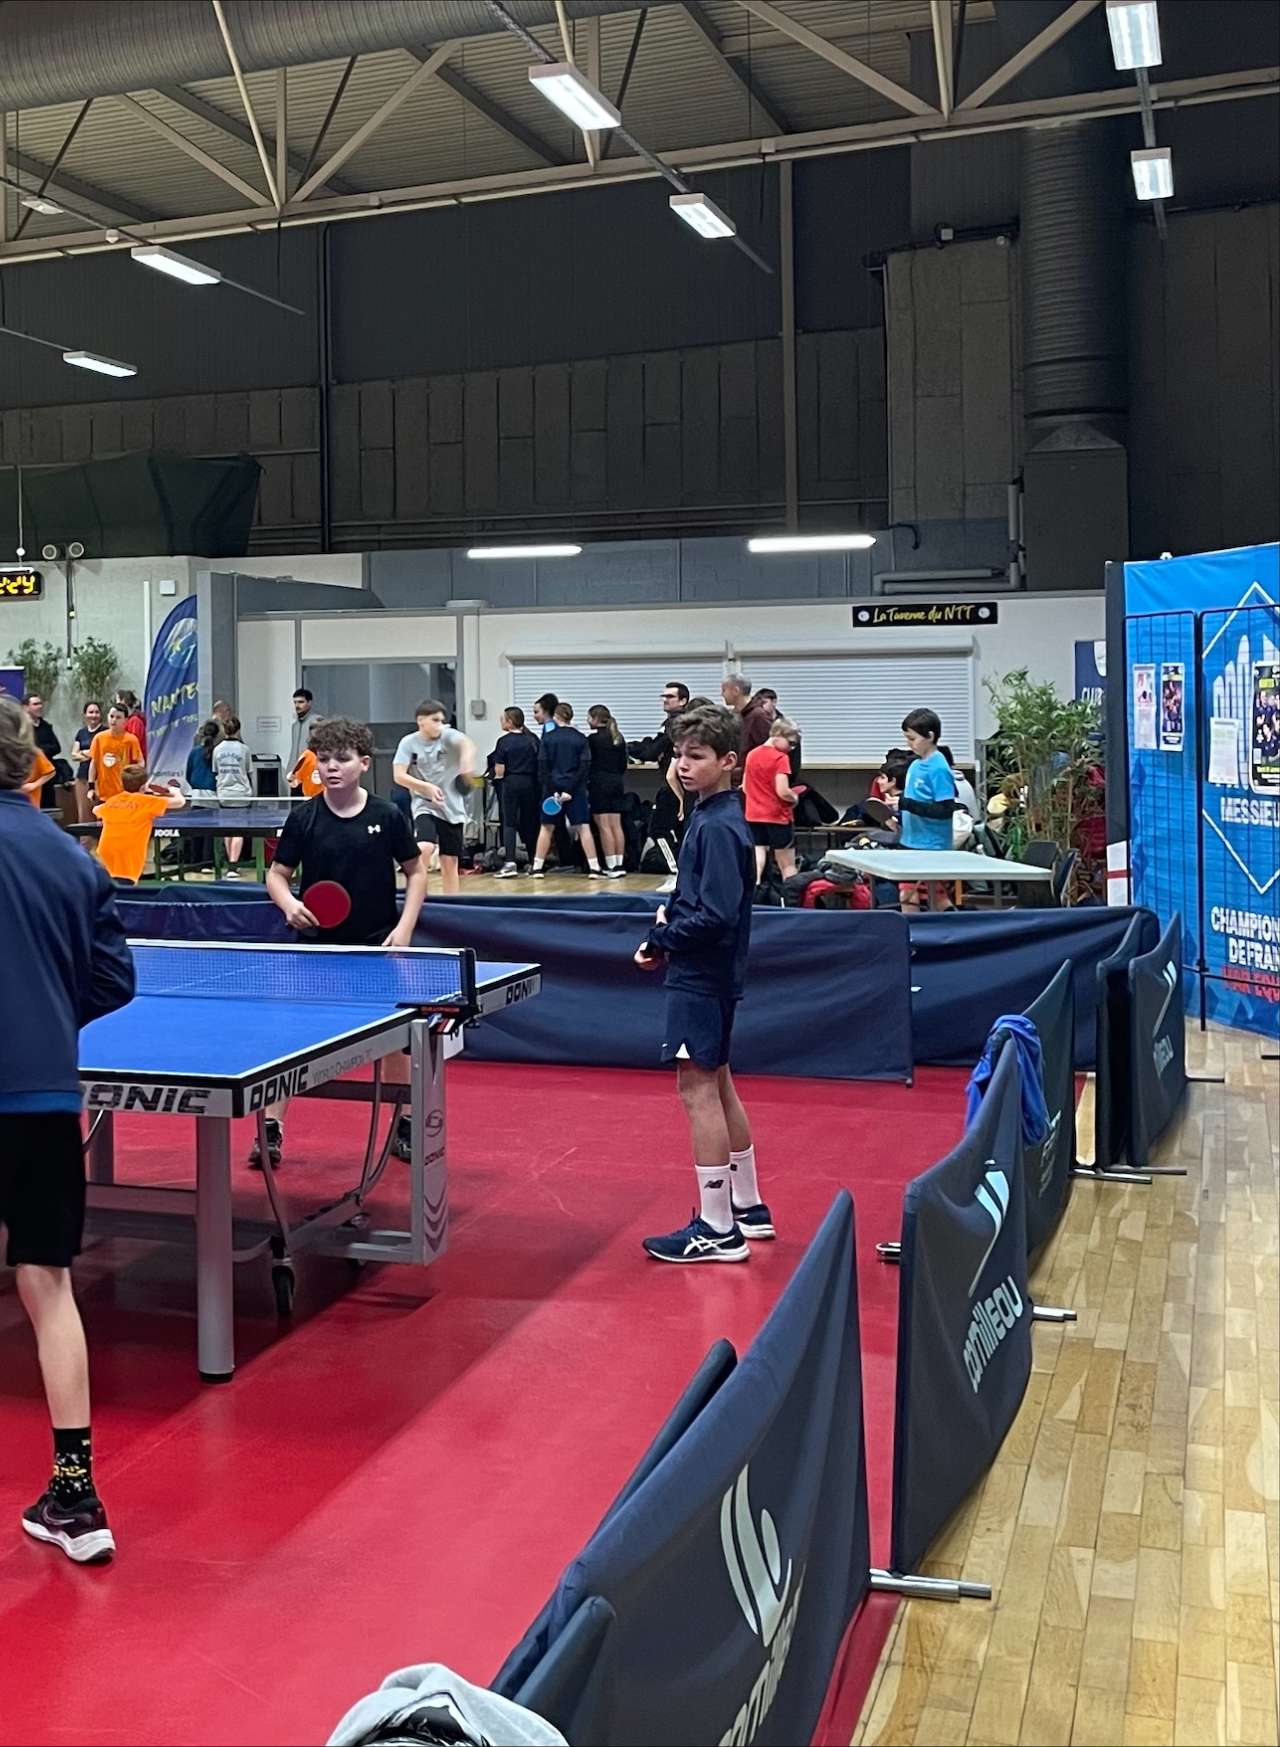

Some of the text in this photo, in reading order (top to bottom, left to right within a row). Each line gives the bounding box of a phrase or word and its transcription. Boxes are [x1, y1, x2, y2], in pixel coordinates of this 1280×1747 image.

[872, 607, 887, 623] La
[927, 606, 943, 623] du
[943, 604, 976, 620] NTT
[154, 828, 181, 837] JOOLA
[79, 1083, 212, 1114] ONIC
[249, 1065, 310, 1112] DONIC
